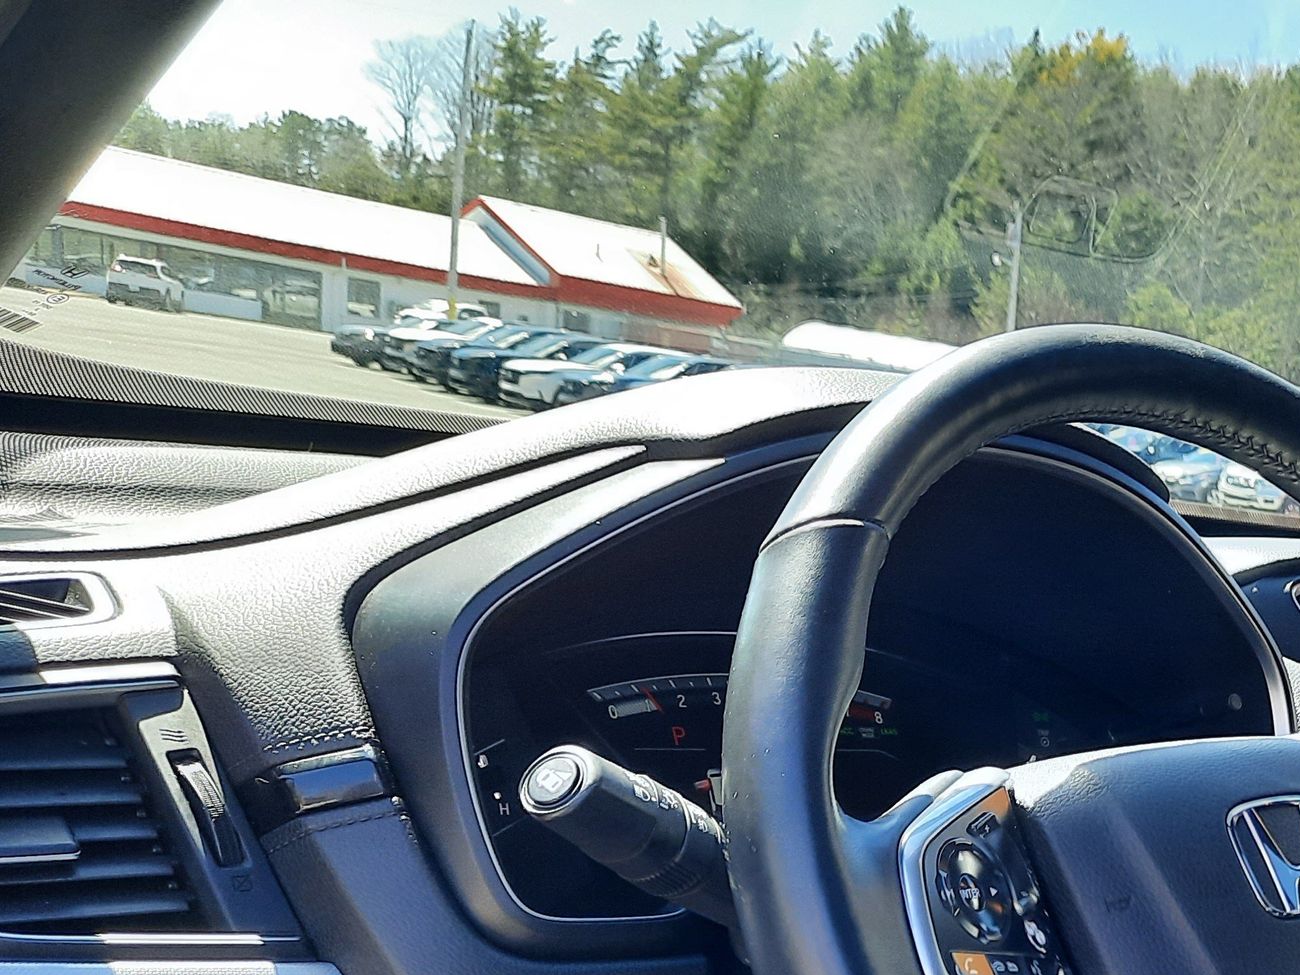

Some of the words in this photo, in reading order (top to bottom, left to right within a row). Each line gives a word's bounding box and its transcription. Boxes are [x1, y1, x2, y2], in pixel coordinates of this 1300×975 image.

[676, 694, 688, 708] 2
[711, 691, 722, 706] 3
[874, 711, 883, 724] 8
[671, 726, 686, 746] P
[499, 802, 510, 816] H
